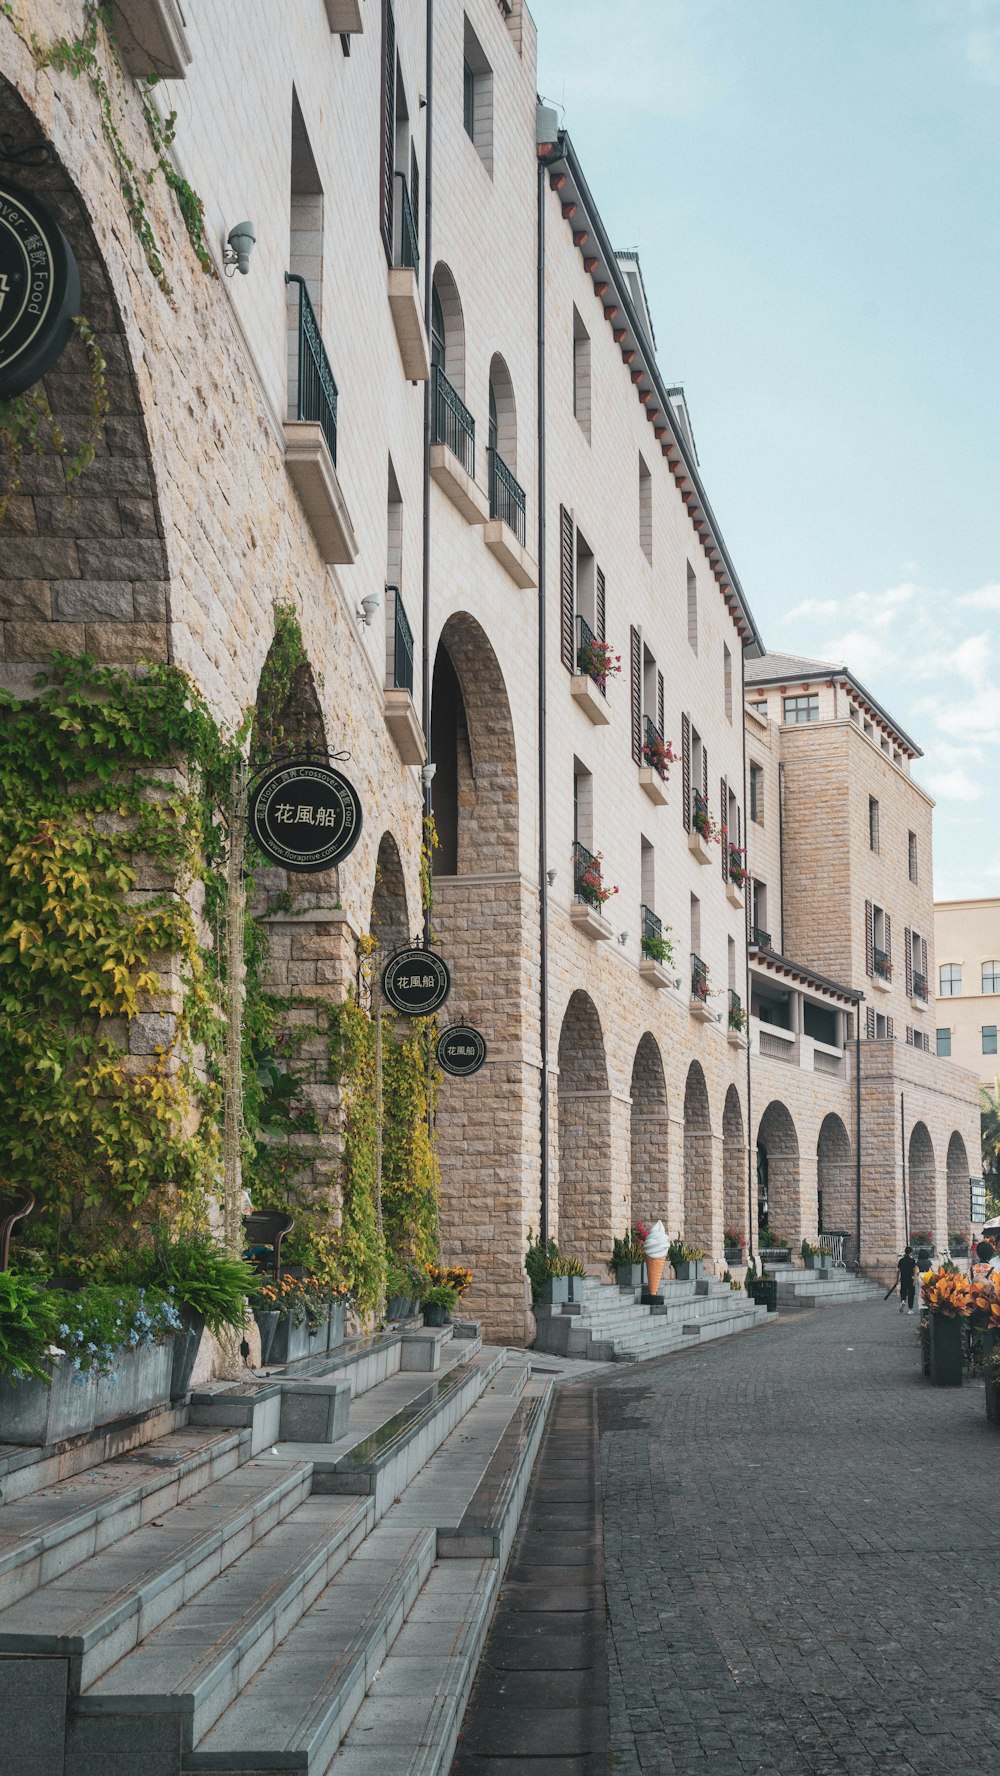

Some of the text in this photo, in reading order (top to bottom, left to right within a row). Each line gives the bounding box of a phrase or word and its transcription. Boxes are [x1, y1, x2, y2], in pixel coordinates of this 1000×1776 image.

[24, 234, 47, 267] 餐飲
[27, 272, 48, 314] Food
[260, 780, 278, 802] Floral
[299, 769, 339, 787] Crossover
[344, 806, 353, 827] Food
[274, 803, 336, 827] 花風船
[397, 975, 435, 990] 花風船
